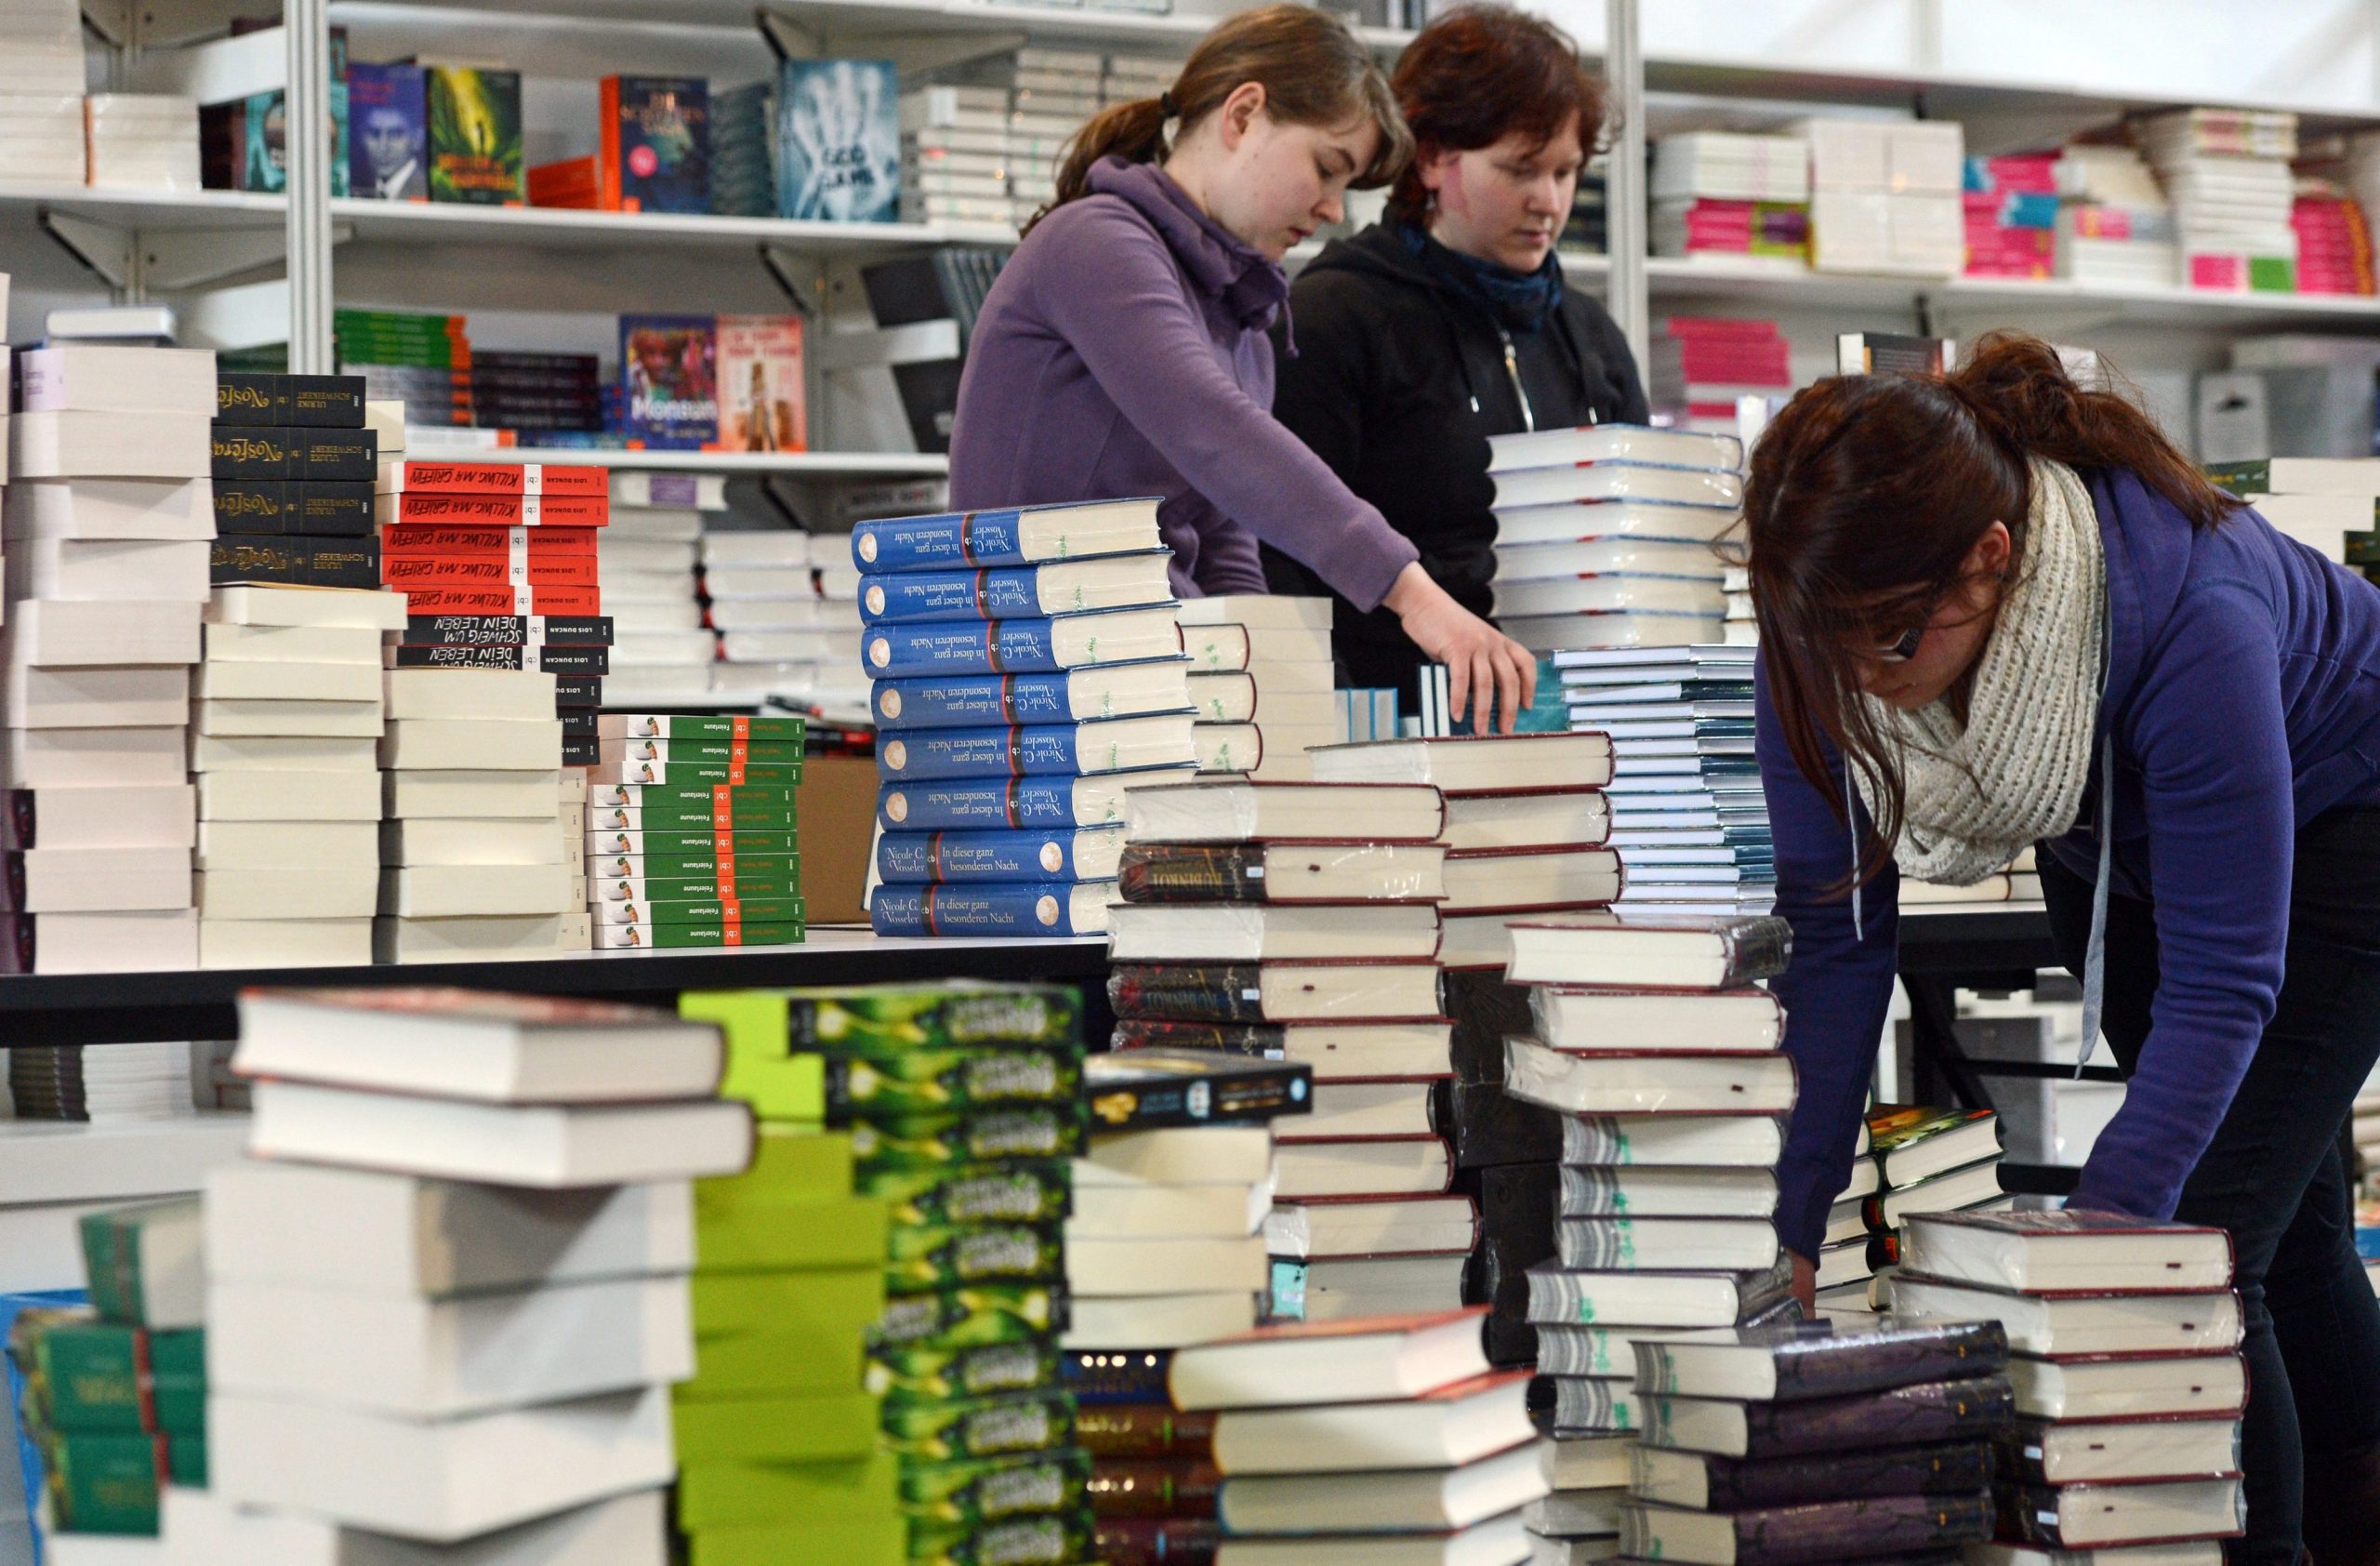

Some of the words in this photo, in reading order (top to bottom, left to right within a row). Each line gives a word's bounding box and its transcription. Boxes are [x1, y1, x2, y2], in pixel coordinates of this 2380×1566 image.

[894, 532, 914, 543] Nacht
[916, 530, 952, 541] besonderen
[974, 525, 1006, 540] Vosseler
[915, 543, 930, 553] ganz
[931, 544, 951, 555] dieser
[952, 545, 960, 553] In
[976, 540, 984, 553] C.
[985, 537, 1011, 551] Nicole
[904, 585, 925, 596] Nacht
[927, 583, 966, 594] besonderen
[989, 579, 1023, 593] Vosseler
[925, 595, 942, 606] ganz
[943, 597, 965, 608] dieser
[966, 598, 973, 607] In
[990, 592, 1000, 606] C.
[1001, 591, 1029, 605] Nicole
[435, 616, 479, 630] LEBEN
[483, 616, 517, 629] DEIN
[444, 630, 466, 642] UM
[469, 630, 522, 645] SCHWEIG
[935, 635, 976, 646] besonderen
[1002, 633, 1038, 647] Vosseler
[911, 638, 933, 648] Nacht
[429, 648, 475, 661] LEBEN
[479, 647, 513, 661] DEIN
[934, 648, 951, 659] ganz
[953, 650, 975, 661] dieser
[976, 650, 984, 660] In
[1002, 646, 1012, 659] C.
[1014, 644, 1043, 658] Nicole
[923, 689, 945, 698] Nacht
[948, 687, 991, 699] besonderen
[1017, 684, 1054, 698] Vosseler
[947, 701, 965, 710] ganz
[966, 701, 989, 712] dieser
[991, 702, 999, 711] In
[1018, 698, 1028, 711] C.
[1030, 697, 1059, 710] Nicole
[929, 741, 951, 751] Nacht
[954, 739, 997, 750] besonderen
[1024, 736, 1061, 749] Vosseler
[952, 752, 969, 763] ganz
[972, 754, 994, 764] dieser
[997, 754, 1005, 763] In
[1024, 750, 1034, 763] C.
[1036, 749, 1067, 762] Nicole
[929, 794, 951, 804] Nacht
[954, 793, 995, 803] besonderen
[1022, 789, 1058, 803] Vosseler
[952, 805, 969, 815] ganz
[972, 807, 993, 817] dieser
[996, 807, 1003, 816] In
[1022, 804, 1032, 816] C.
[1034, 802, 1063, 816] Nicole
[886, 847, 913, 860] Nicole
[914, 847, 923, 860] C.
[942, 847, 951, 857] In
[953, 846, 974, 857] dieser
[976, 849, 994, 860] ganz
[889, 860, 925, 872] Vosseler
[950, 859, 993, 871] besonderen
[995, 860, 1019, 871] Nacht
[879, 899, 907, 912] Nicole
[908, 899, 918, 911] C.
[937, 899, 945, 909] In
[947, 898, 969, 909] dieser
[971, 901, 989, 912] ganz
[883, 912, 918, 924] Vosseler
[945, 911, 988, 923] besonderen
[990, 912, 1014, 923] Nacht
